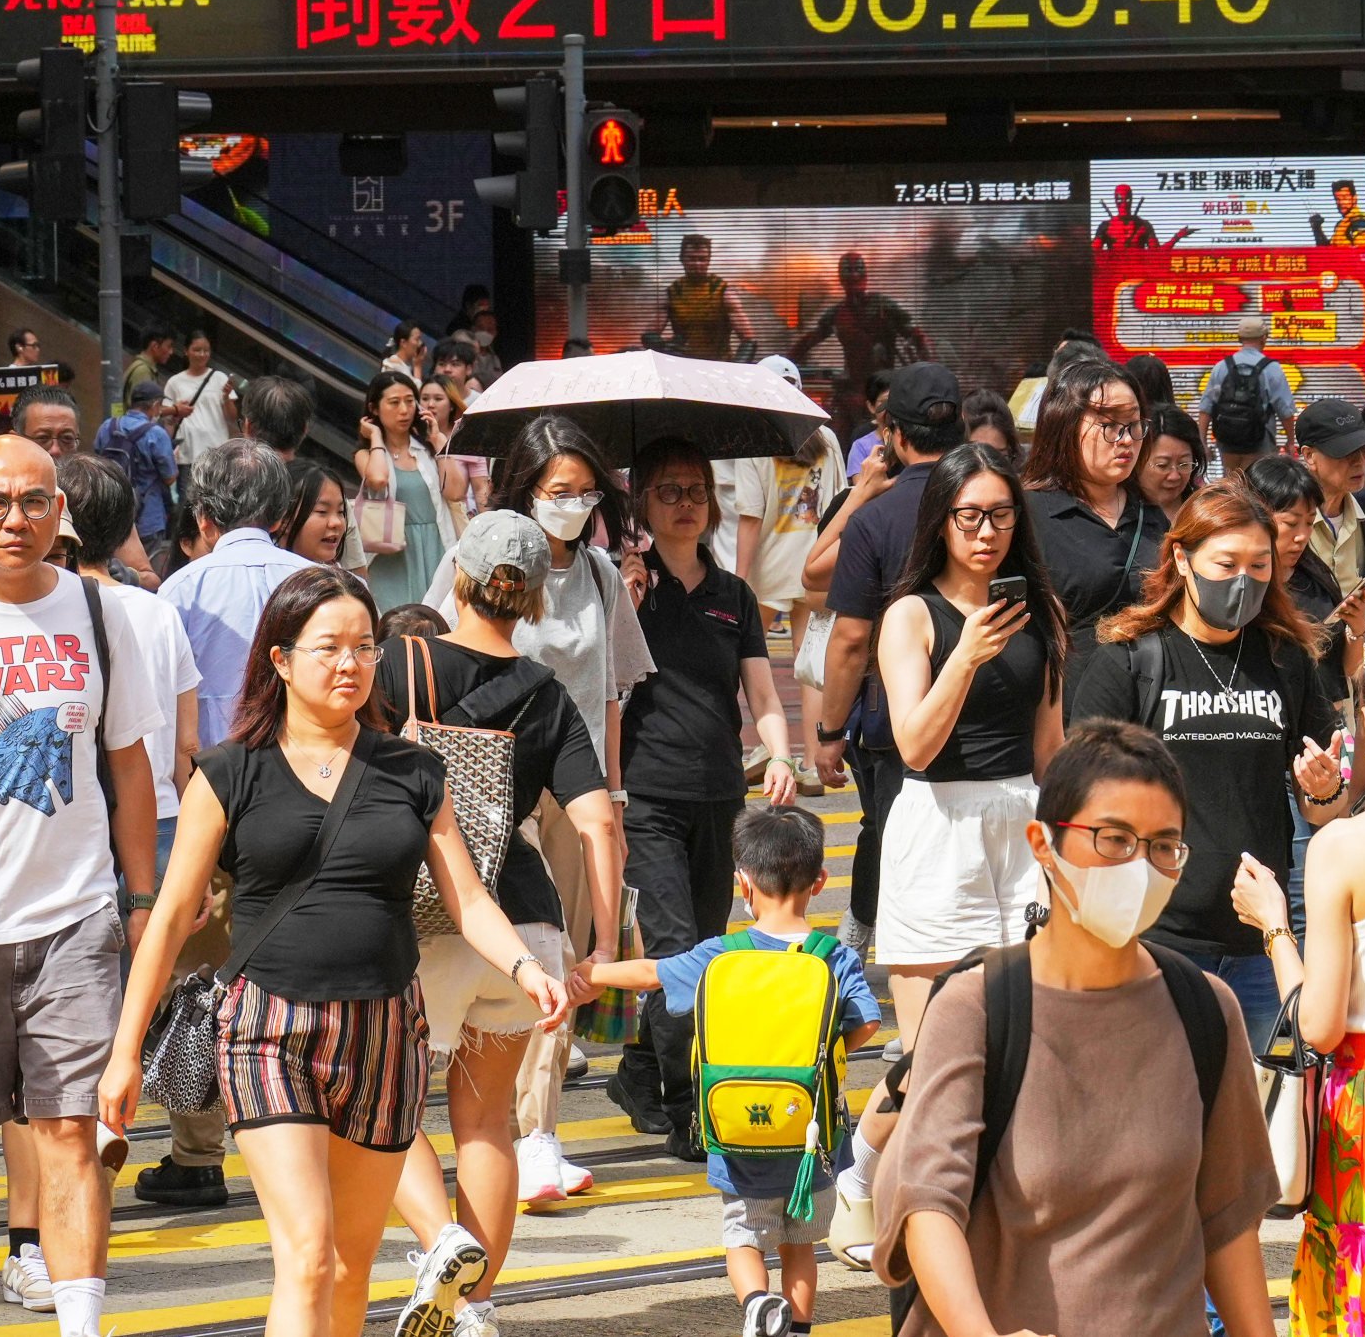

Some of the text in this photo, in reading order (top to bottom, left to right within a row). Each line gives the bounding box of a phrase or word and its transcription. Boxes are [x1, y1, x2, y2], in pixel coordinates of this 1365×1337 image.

[894, 181, 973, 204] 7.24(三)
[425, 200, 464, 232] 3F
[1160, 689, 1284, 731] THRASHER
[1163, 731, 1282, 741] SKATEBOARD MAGAZINE
